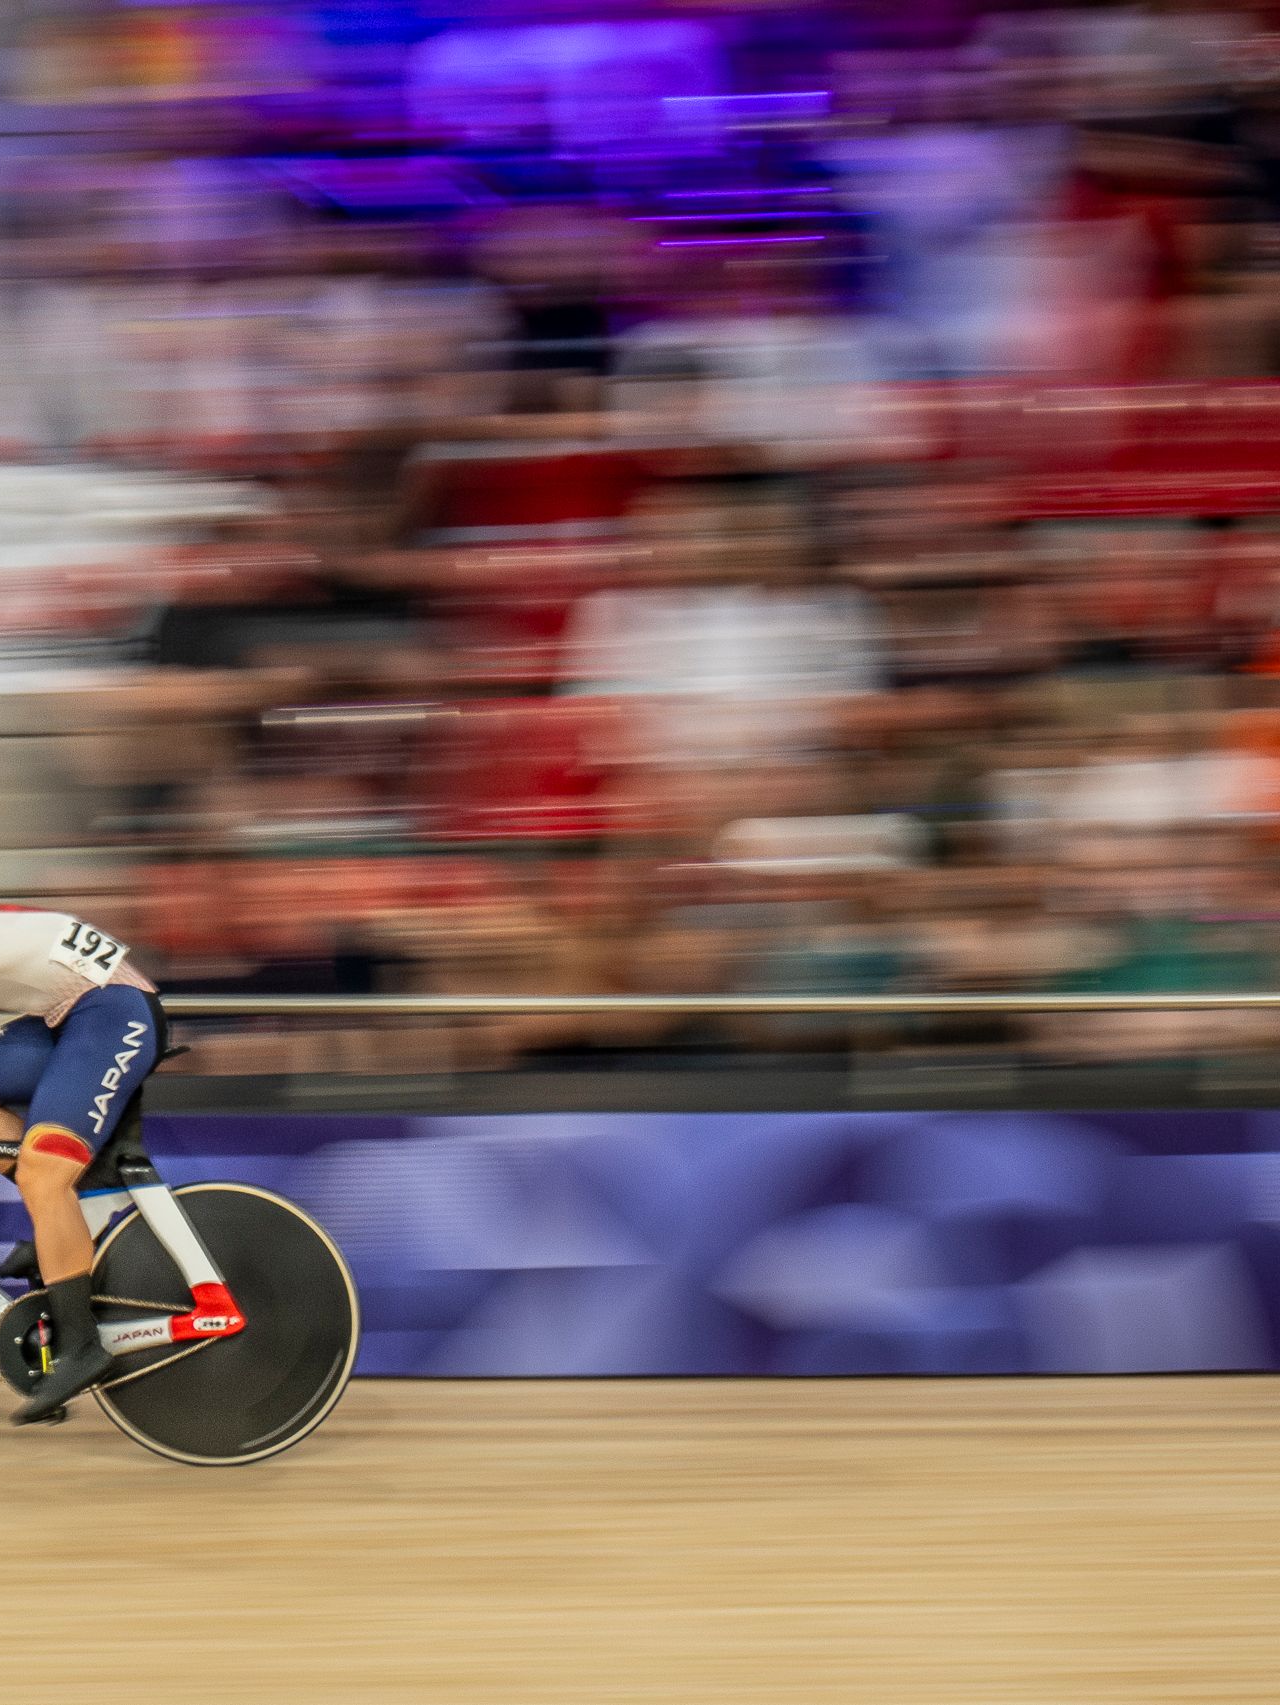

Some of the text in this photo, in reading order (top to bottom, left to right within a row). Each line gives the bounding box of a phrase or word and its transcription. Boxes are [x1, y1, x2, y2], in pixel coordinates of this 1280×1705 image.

[60, 921, 119, 971] 192
[88, 1021, 148, 1134] JAPAN
[112, 1326, 164, 1343] JAPAN
